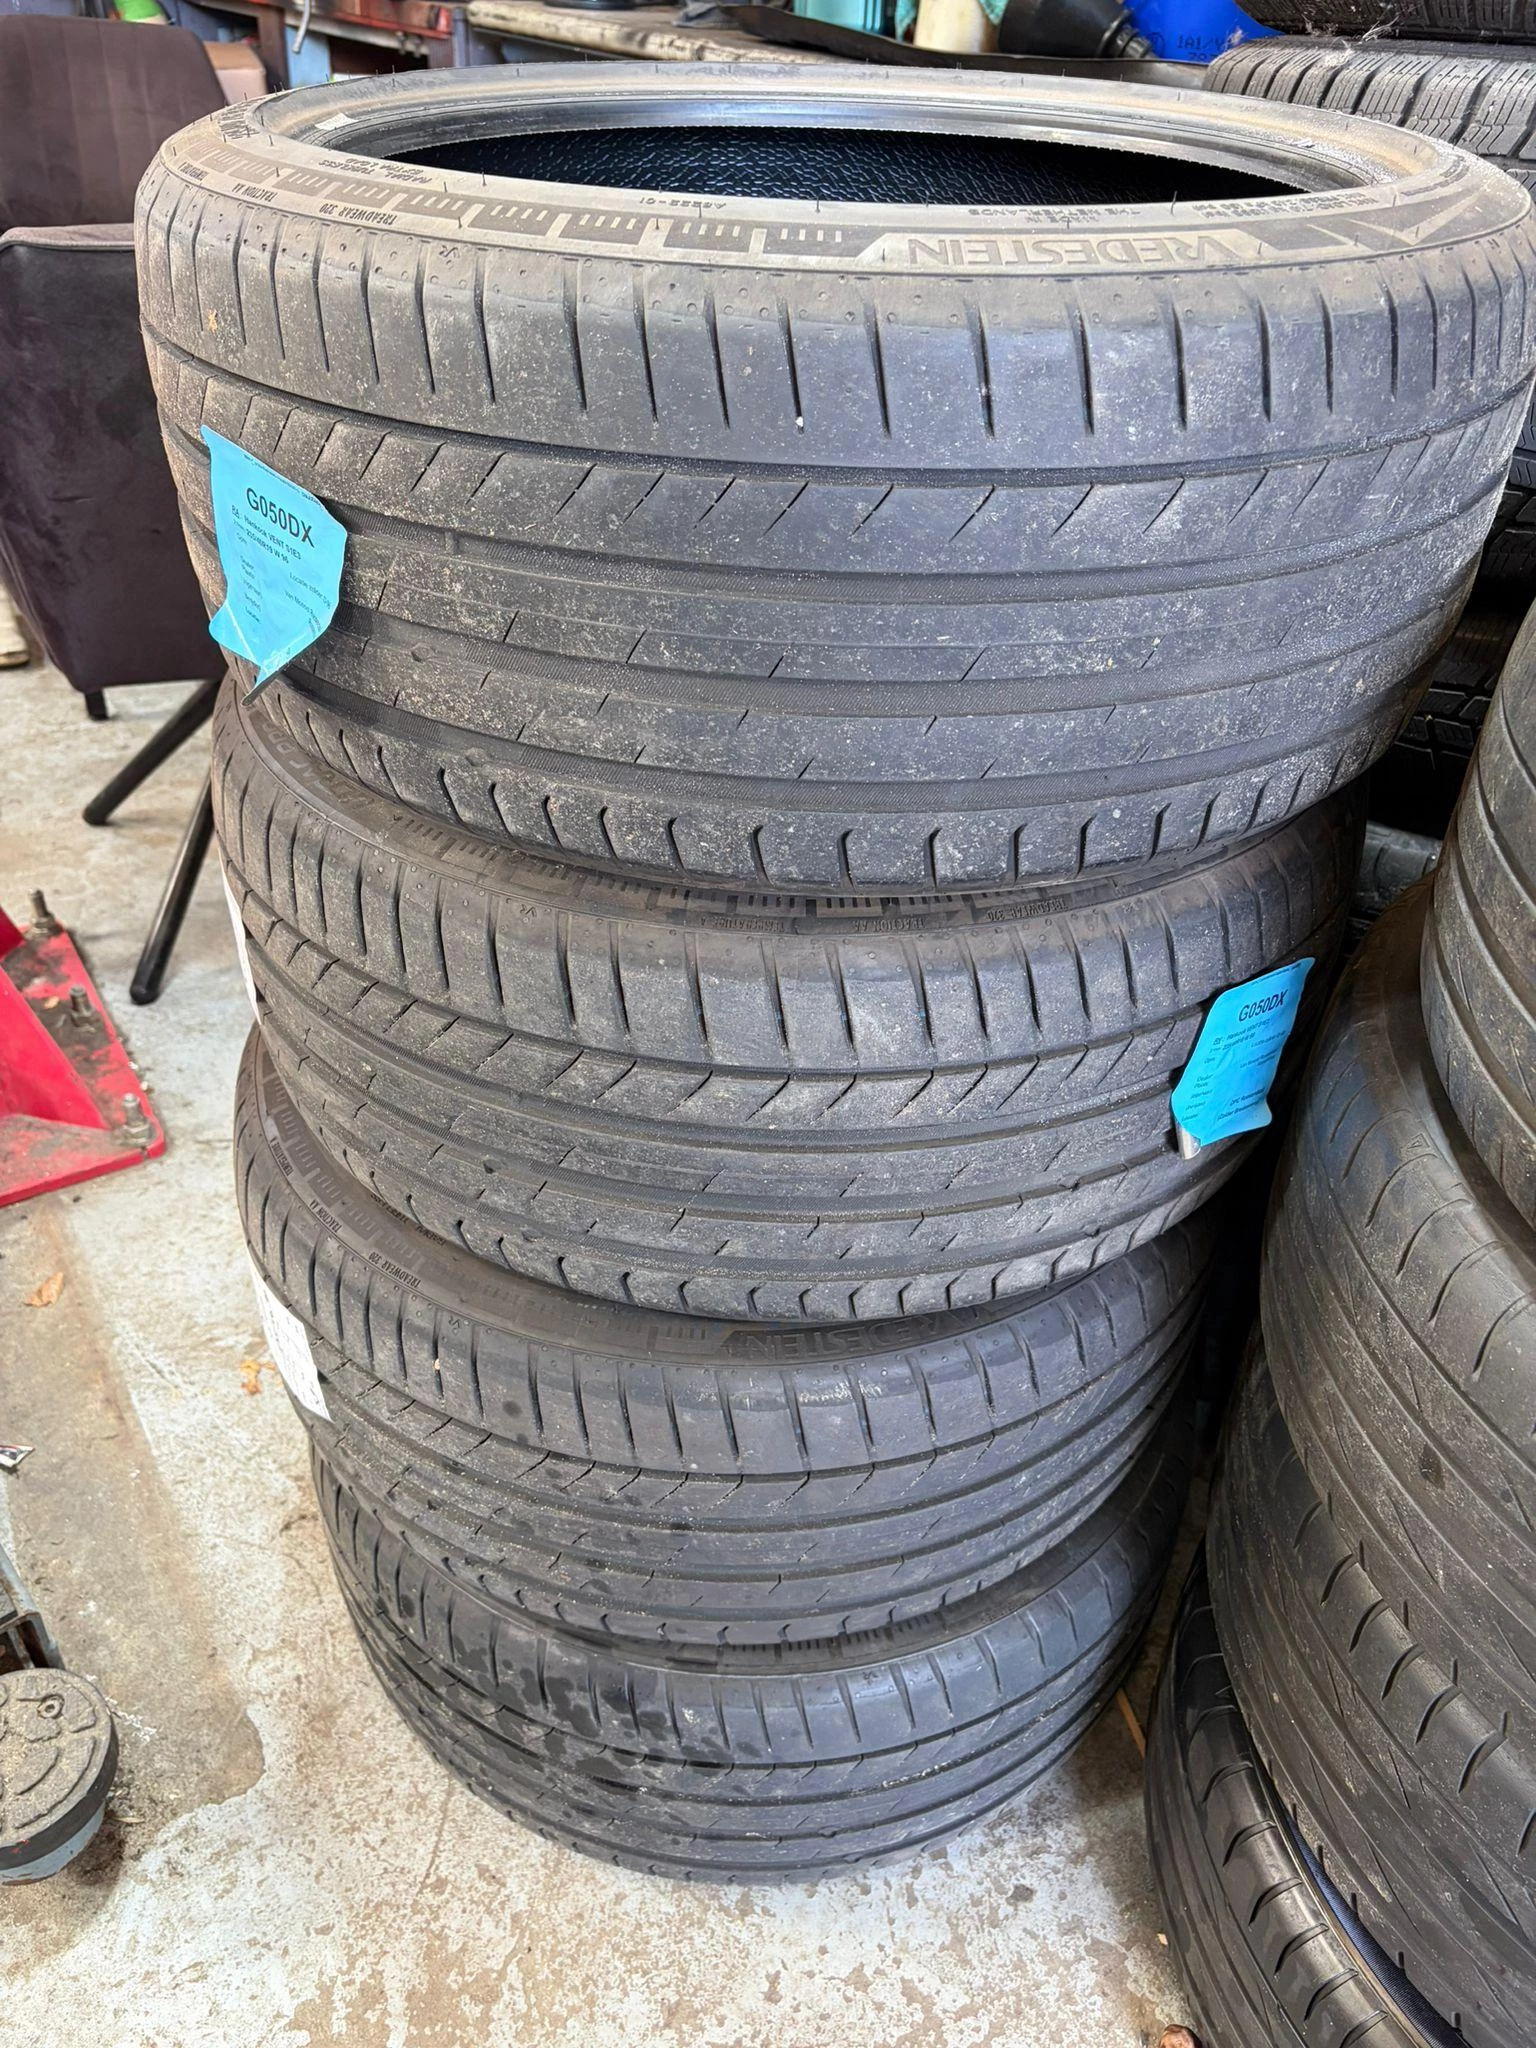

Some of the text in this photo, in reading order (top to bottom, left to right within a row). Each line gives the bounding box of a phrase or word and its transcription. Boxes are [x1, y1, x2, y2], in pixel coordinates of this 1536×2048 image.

[384, 170, 431, 185] RADIAL
[243, 185, 277, 202] TRACTION
[318, 202, 397, 226] TREADWEAR 320
[968, 207, 1101, 216] NETHERLANDS
[908, 234, 1237, 267] VREDESTEIN
[246, 487, 315, 548] G050DX
[1009, 897, 1068, 919] TREADWEAR
[711, 918, 785, 932] TEMPERATURE
[872, 917, 925, 932] TRACTION
[1238, 989, 1289, 1022] G050DX
[316, 1207, 342, 1233] TRACTION
[367, 1250, 421, 1289] TREADWEAR 320
